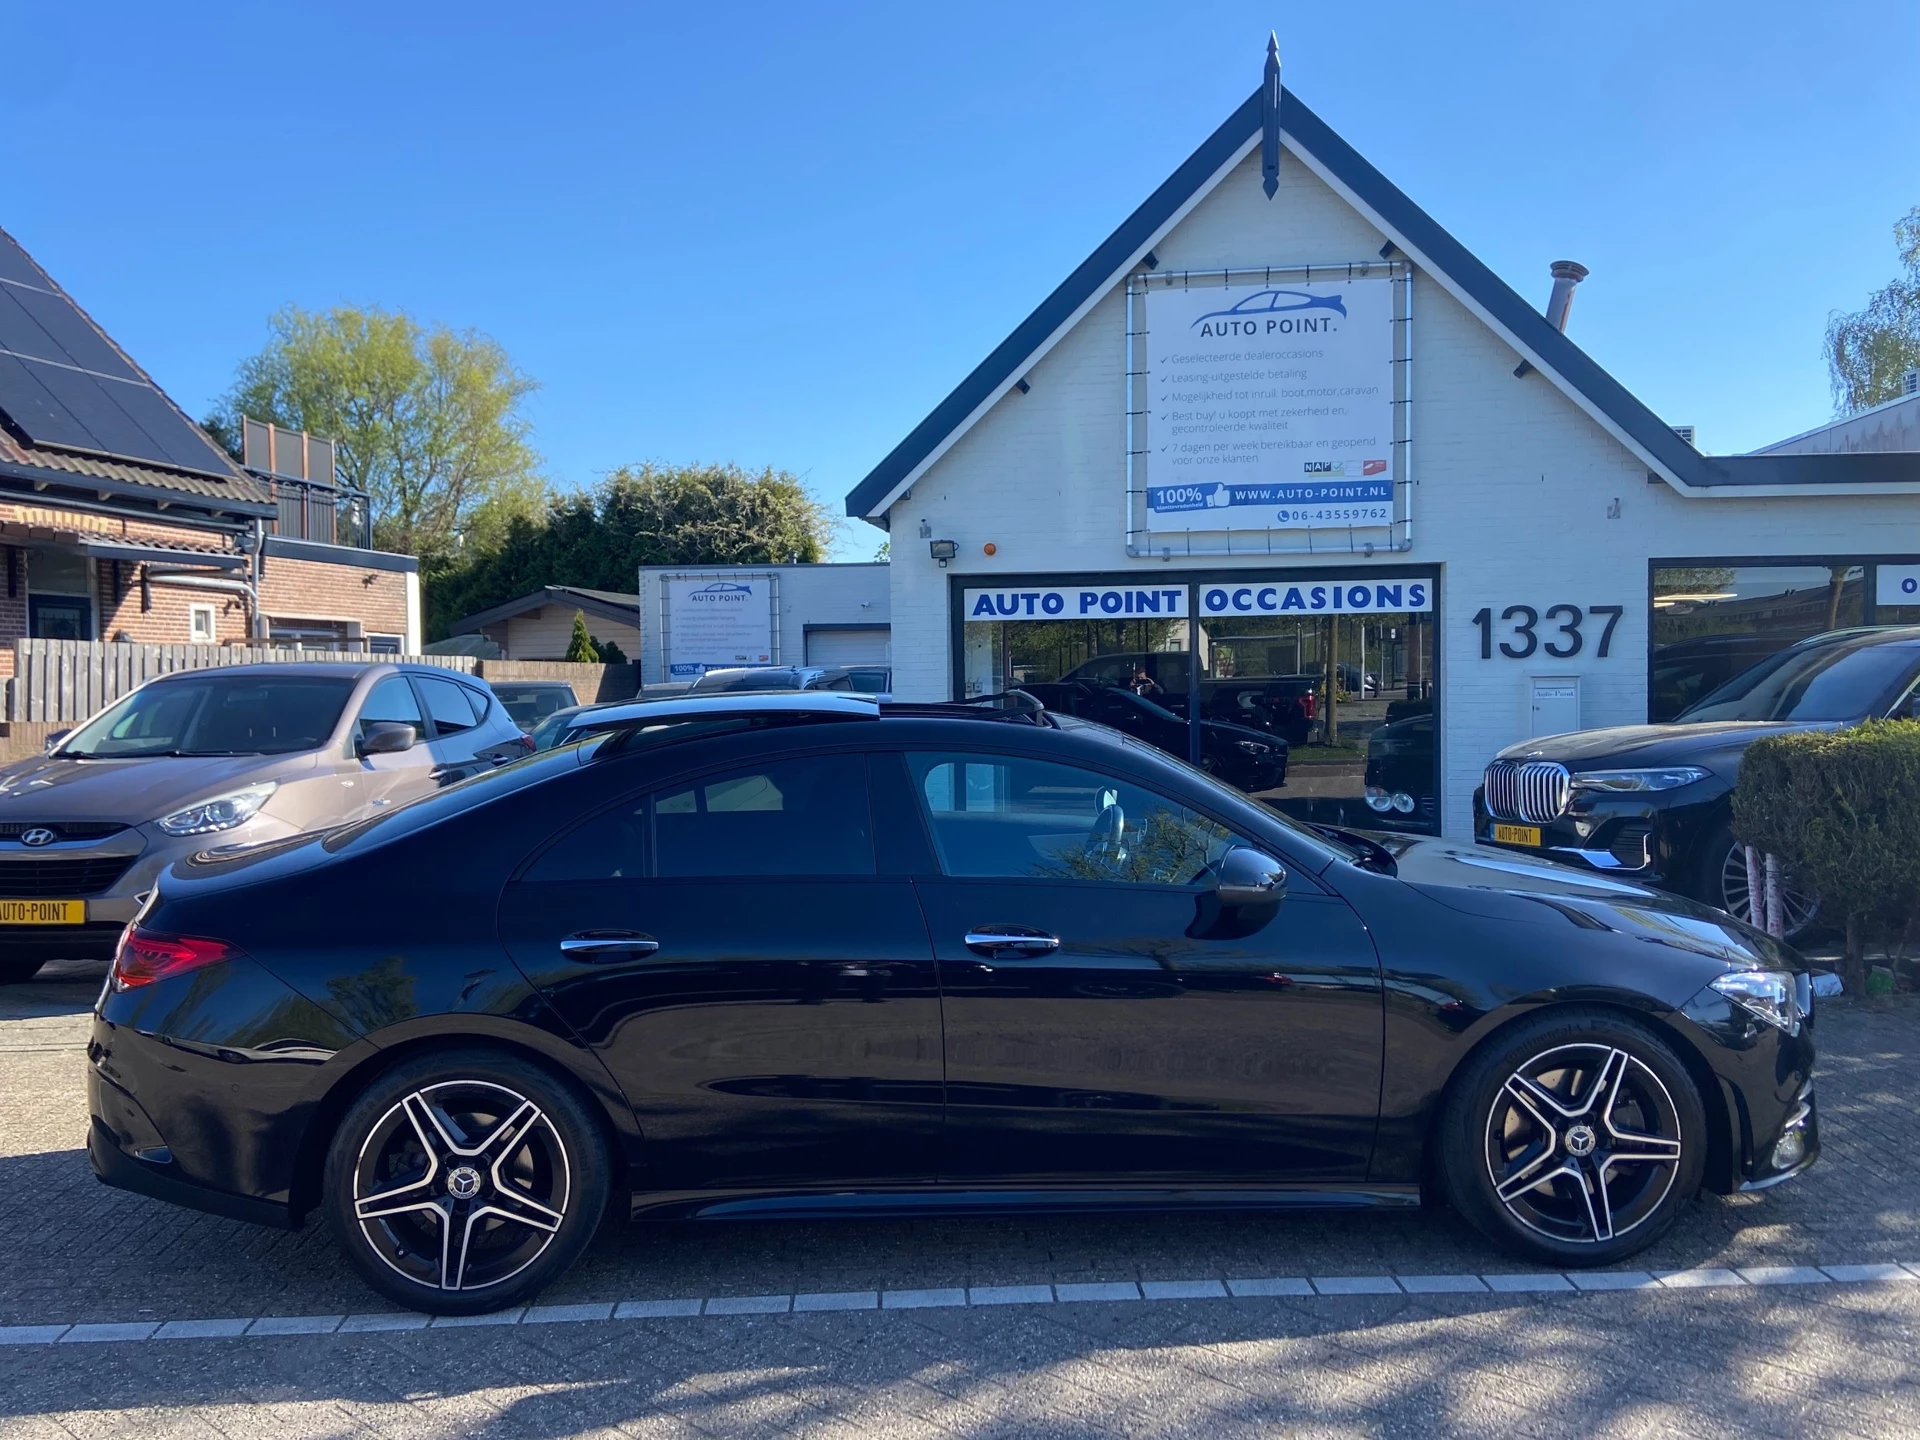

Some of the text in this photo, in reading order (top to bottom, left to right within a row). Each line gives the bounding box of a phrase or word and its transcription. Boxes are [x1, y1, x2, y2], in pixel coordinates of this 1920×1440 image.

[1200, 320, 1257, 337] AUTO
[1171, 349, 1324, 364] Geselecteerde dealeroccasions
[1171, 368, 1308, 384] Leasing-uitgestelde betaling
[1172, 386, 1379, 403] Mogelijkheid tot inruil: boot,motor,caravan
[1172, 411, 1193, 421] Best
[1195, 410, 1216, 422] buy!
[1218, 411, 1226, 420] u
[1228, 409, 1256, 420] koopt
[1258, 409, 1278, 418] met
[1280, 406, 1329, 417] zekerheid
[1171, 421, 1288, 436] gecontroleerde kwaliteit
[1172, 436, 1376, 454] 7 dagen per week bereikbaar en geopend
[1171, 454, 1259, 465] voor onze klanten
[1304, 461, 1331, 472] NAP
[1156, 488, 1203, 504] 100%
[1235, 487, 1387, 500] WWW.AUTO-POINT.NL
[1292, 508, 1387, 520] 06-43559762
[692, 594, 716, 602] AUTO
[972, 584, 1426, 616] AUTO POINT OCCASIONS
[1472, 604, 1624, 660] 1337
[674, 665, 694, 673] 100%
[1498, 826, 1532, 843] AUTO-POINT
